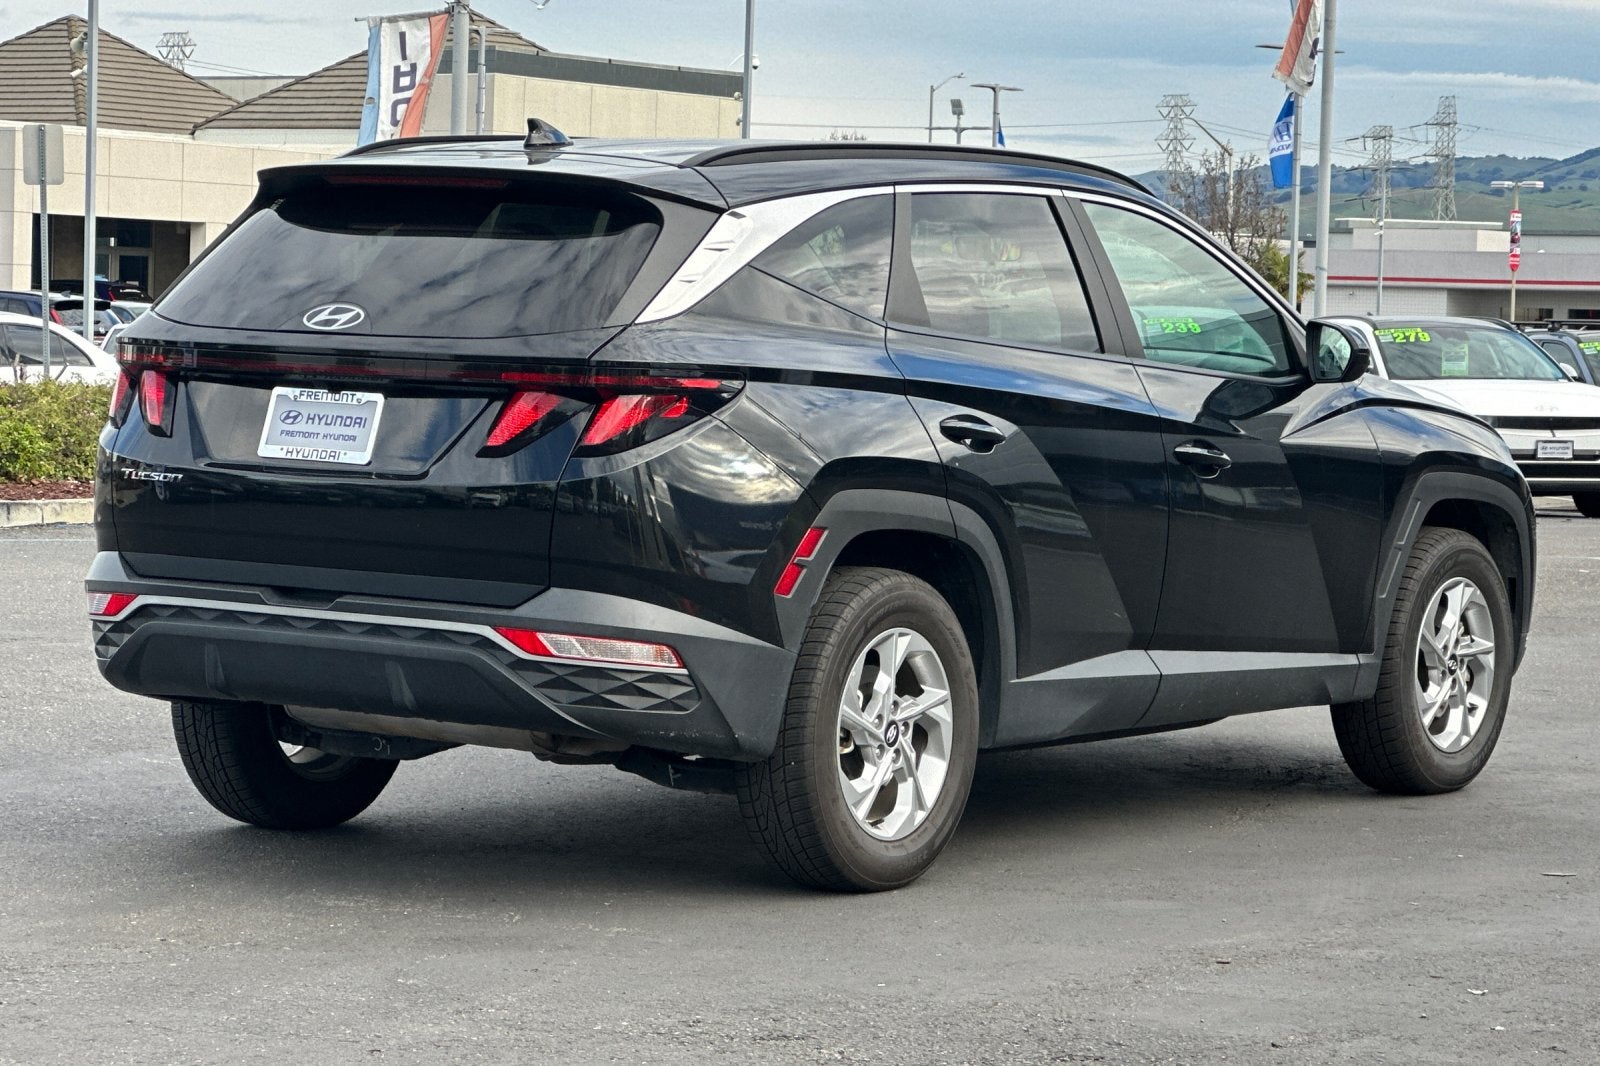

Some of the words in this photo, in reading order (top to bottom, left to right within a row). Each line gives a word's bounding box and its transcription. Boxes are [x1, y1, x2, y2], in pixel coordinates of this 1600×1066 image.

[1162, 322, 1201, 333] 239
[1393, 331, 1431, 343] 279
[299, 390, 357, 402] FREMONT
[305, 413, 367, 428] HYUNDAI
[279, 429, 320, 440] FREMONT
[321, 433, 358, 443] HYUNDAI
[285, 446, 341, 461] HYUNDAI
